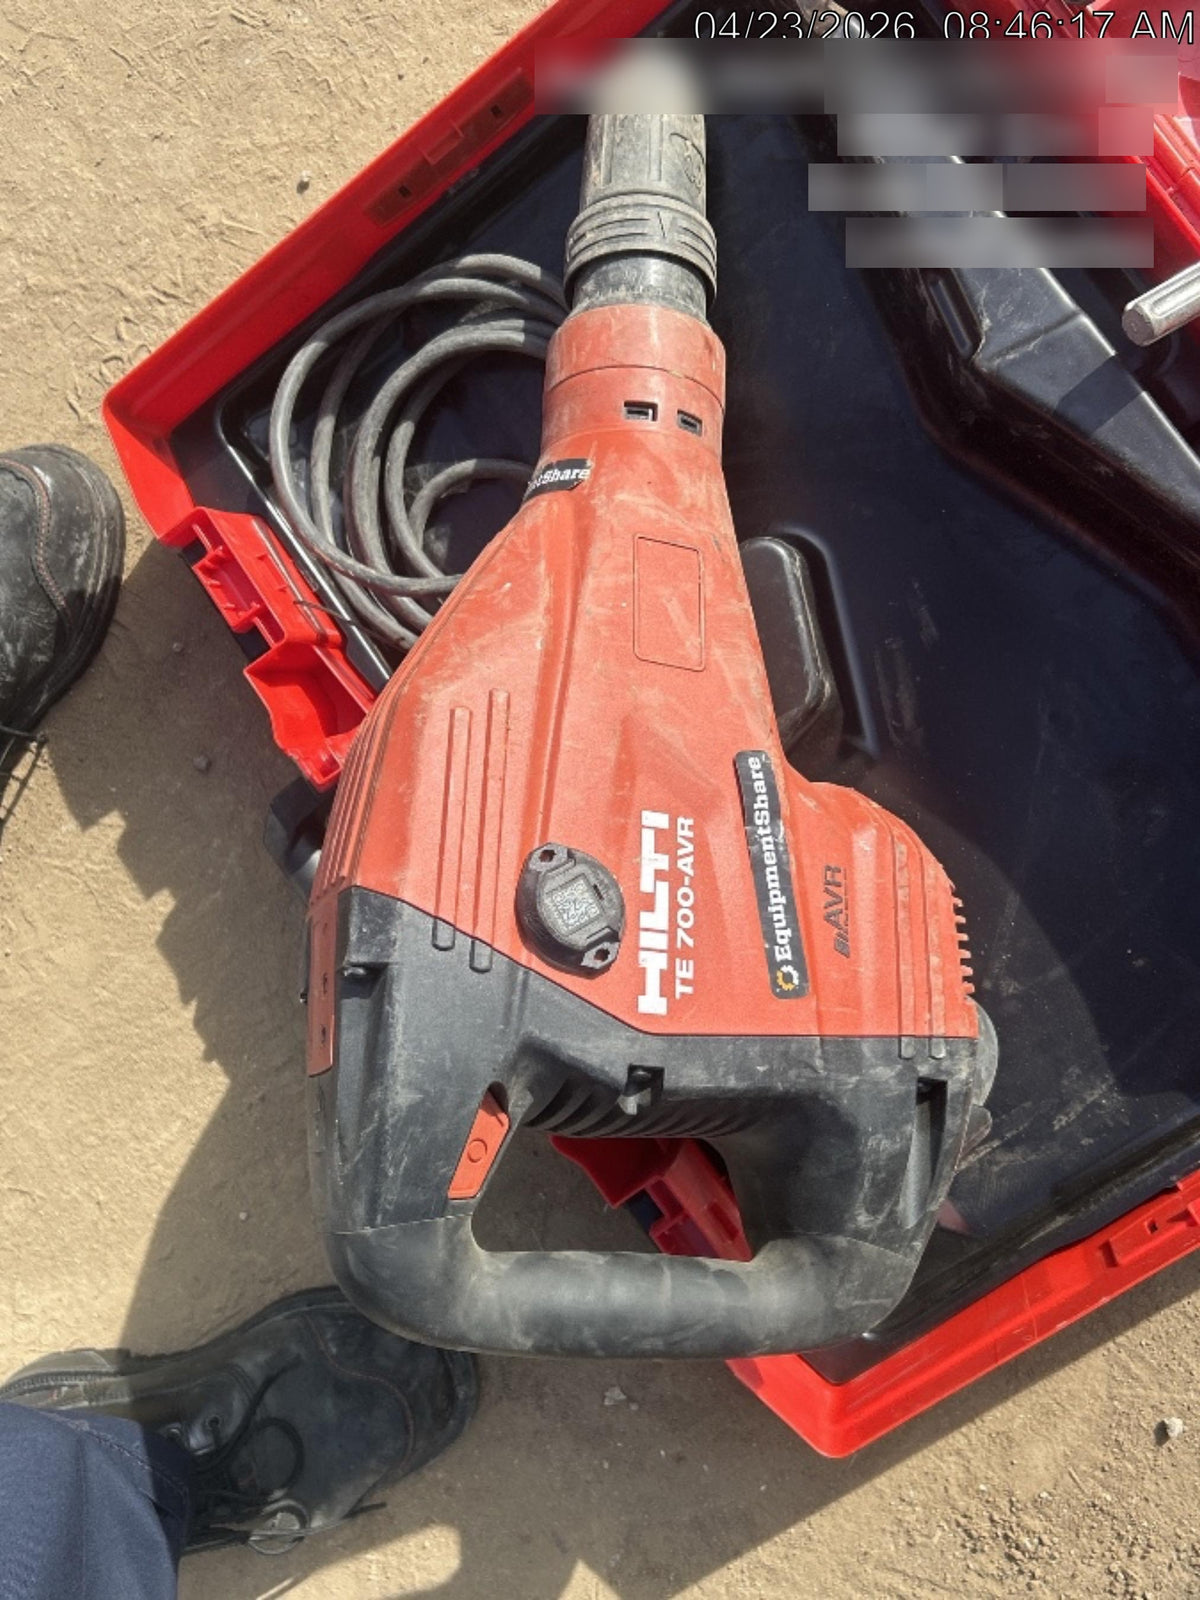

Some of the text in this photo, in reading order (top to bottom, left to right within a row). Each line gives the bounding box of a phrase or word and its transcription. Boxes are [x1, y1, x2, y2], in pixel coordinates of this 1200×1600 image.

[638, 810, 669, 1015] HILTI
[675, 816, 695, 999] TE 700-AVR
[748, 756, 792, 962] EquipmentShare
[823, 865, 848, 934] AVR
